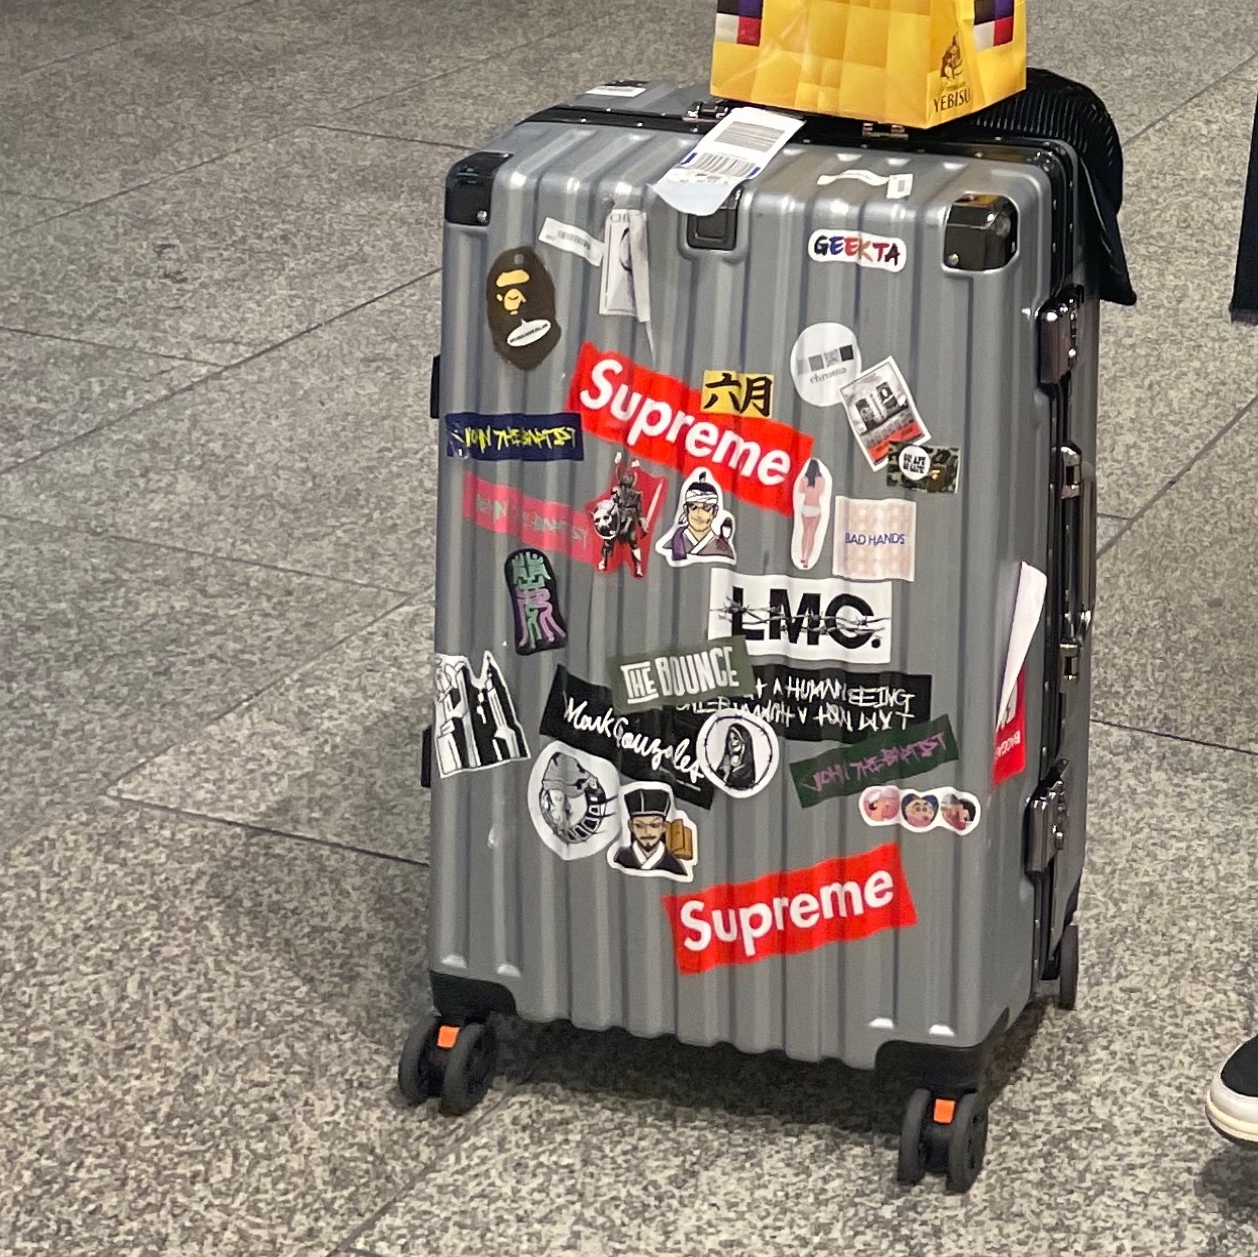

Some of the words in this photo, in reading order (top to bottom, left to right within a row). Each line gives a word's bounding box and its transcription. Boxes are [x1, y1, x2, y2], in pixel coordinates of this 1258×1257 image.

[933, 86, 971, 113] YEBISU
[814, 235, 901, 266] GEEKTA
[703, 372, 774, 417] 六月
[809, 365, 848, 384] chroma
[579, 358, 792, 486] Supreme
[844, 532, 867, 546] BAD
[868, 532, 906, 546] HANDS
[620, 661, 660, 704] THE
[655, 646, 740, 697] BOUNCE
[563, 697, 612, 737] Mark
[679, 869, 895, 957] Supreme
